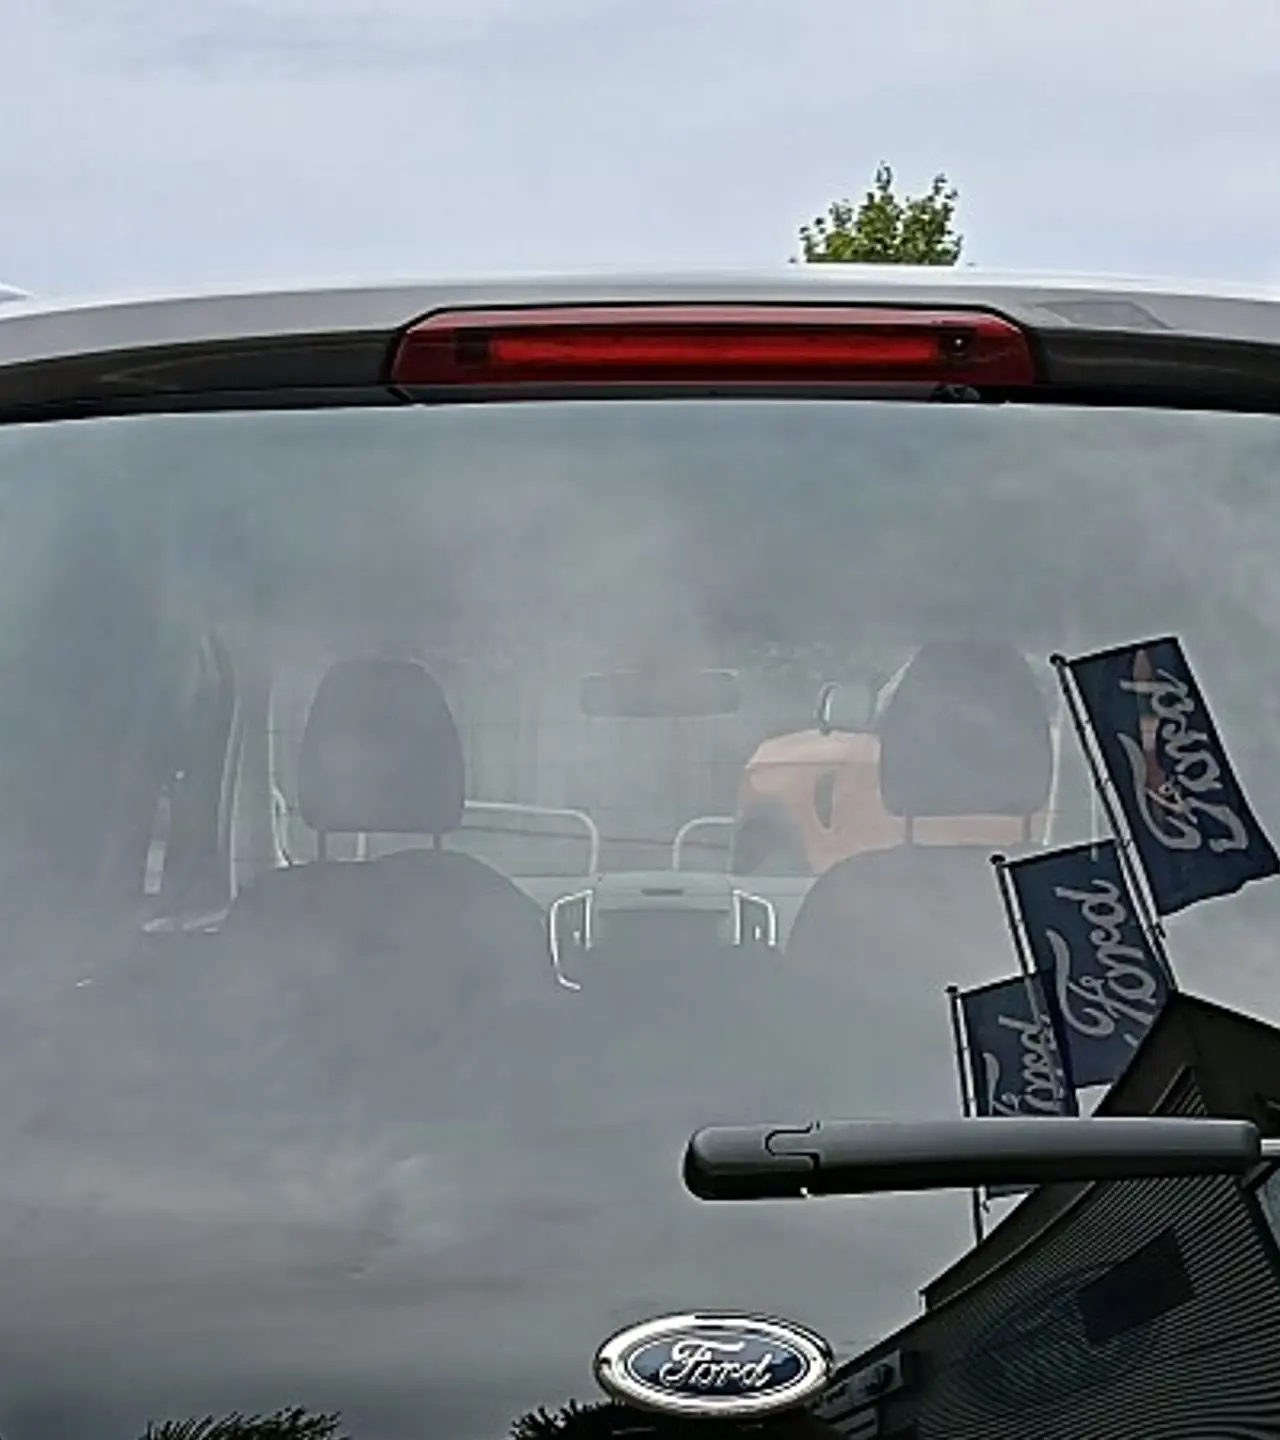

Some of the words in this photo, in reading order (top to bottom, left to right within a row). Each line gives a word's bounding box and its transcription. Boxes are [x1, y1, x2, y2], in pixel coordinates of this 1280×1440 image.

[1117, 667, 1250, 854] Ford
[1046, 879, 1158, 1049] Ford
[658, 1340, 779, 1389] Ford
